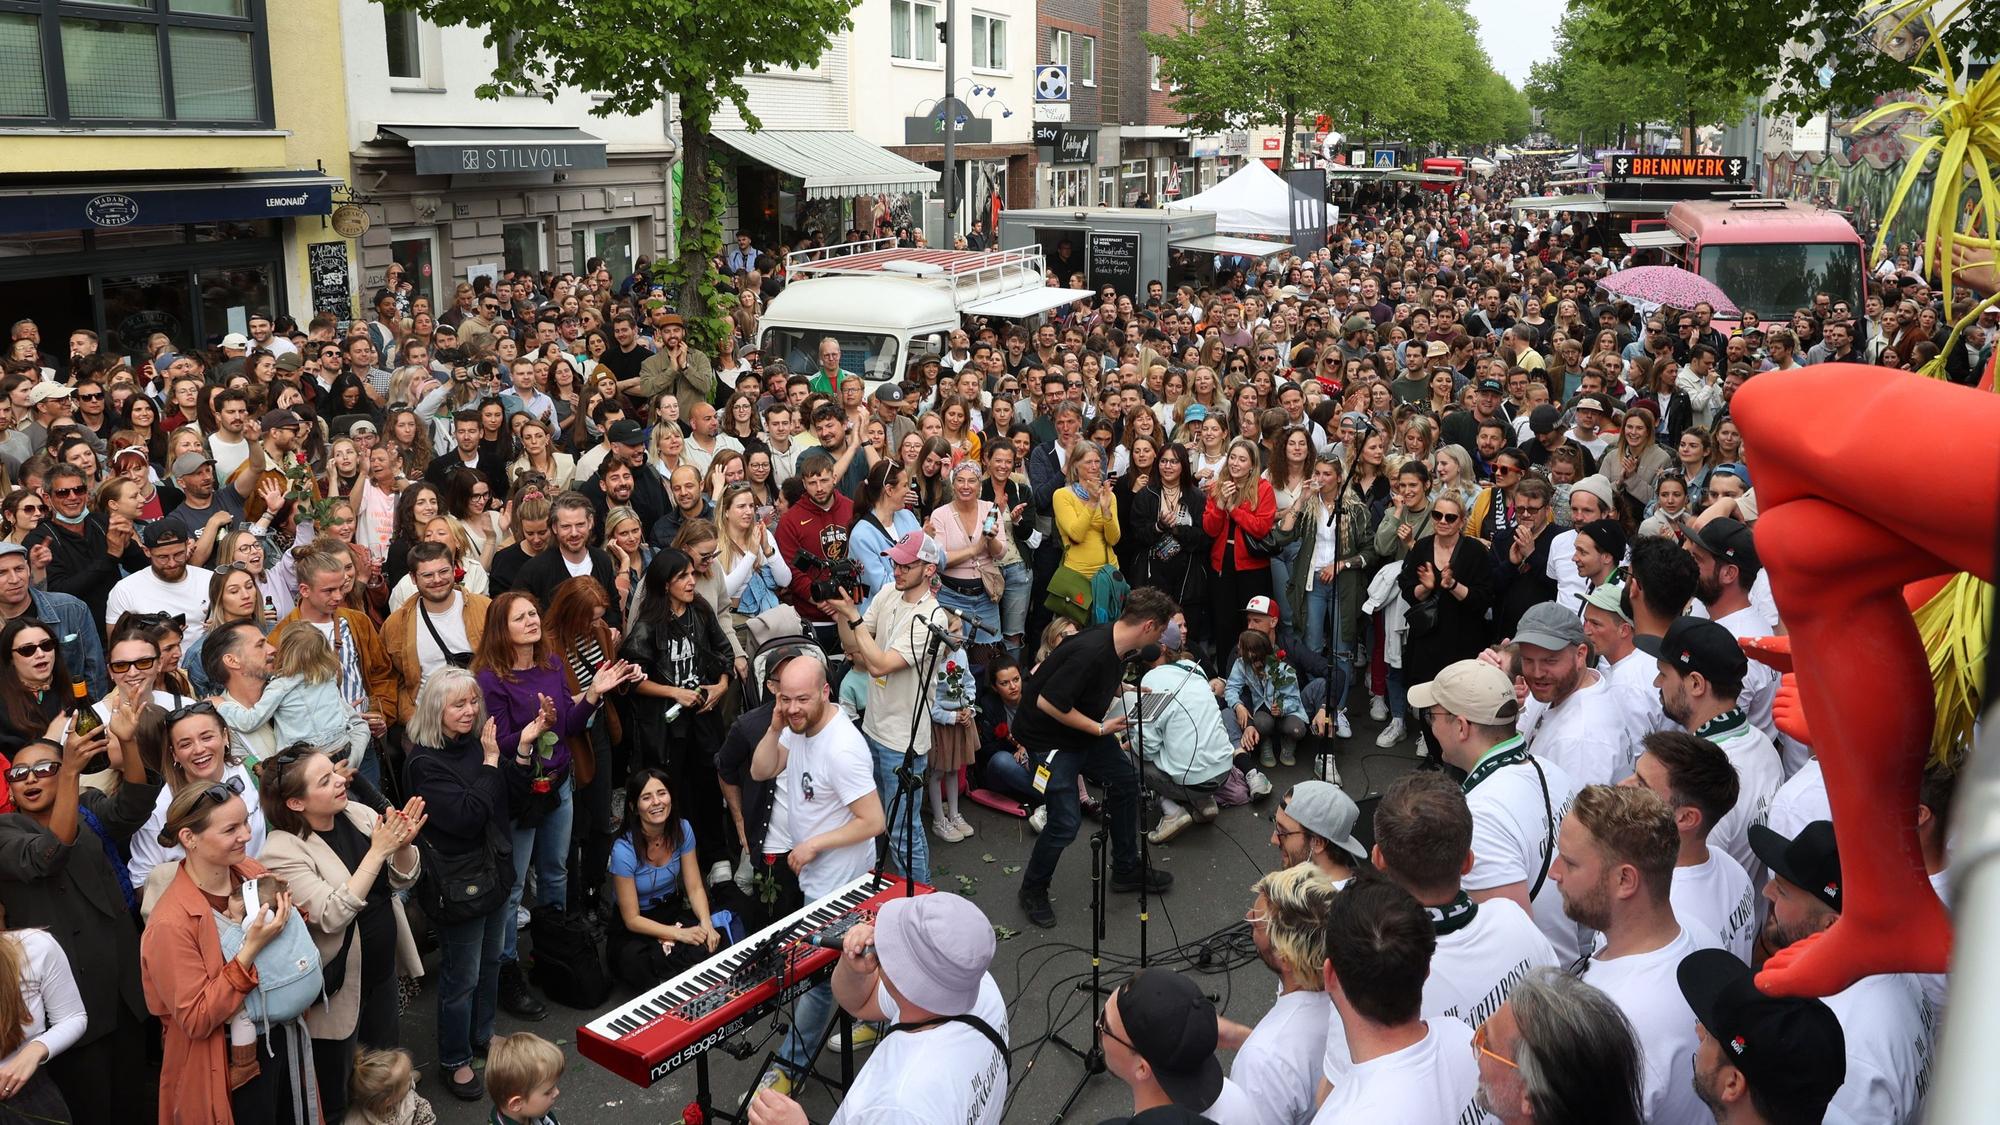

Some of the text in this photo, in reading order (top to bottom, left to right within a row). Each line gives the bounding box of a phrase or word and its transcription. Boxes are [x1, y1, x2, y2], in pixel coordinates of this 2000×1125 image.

[1037, 127, 1058, 141] sky
[486, 148, 573, 169] STILVOLL
[1632, 158, 1725, 176] BRENNWERK
[94, 196, 129, 206] MADAME
[96, 214, 131, 225] TARTINE
[651, 1017, 745, 1080] nord stage 2 EX
[971, 1072, 982, 1093] DIE
